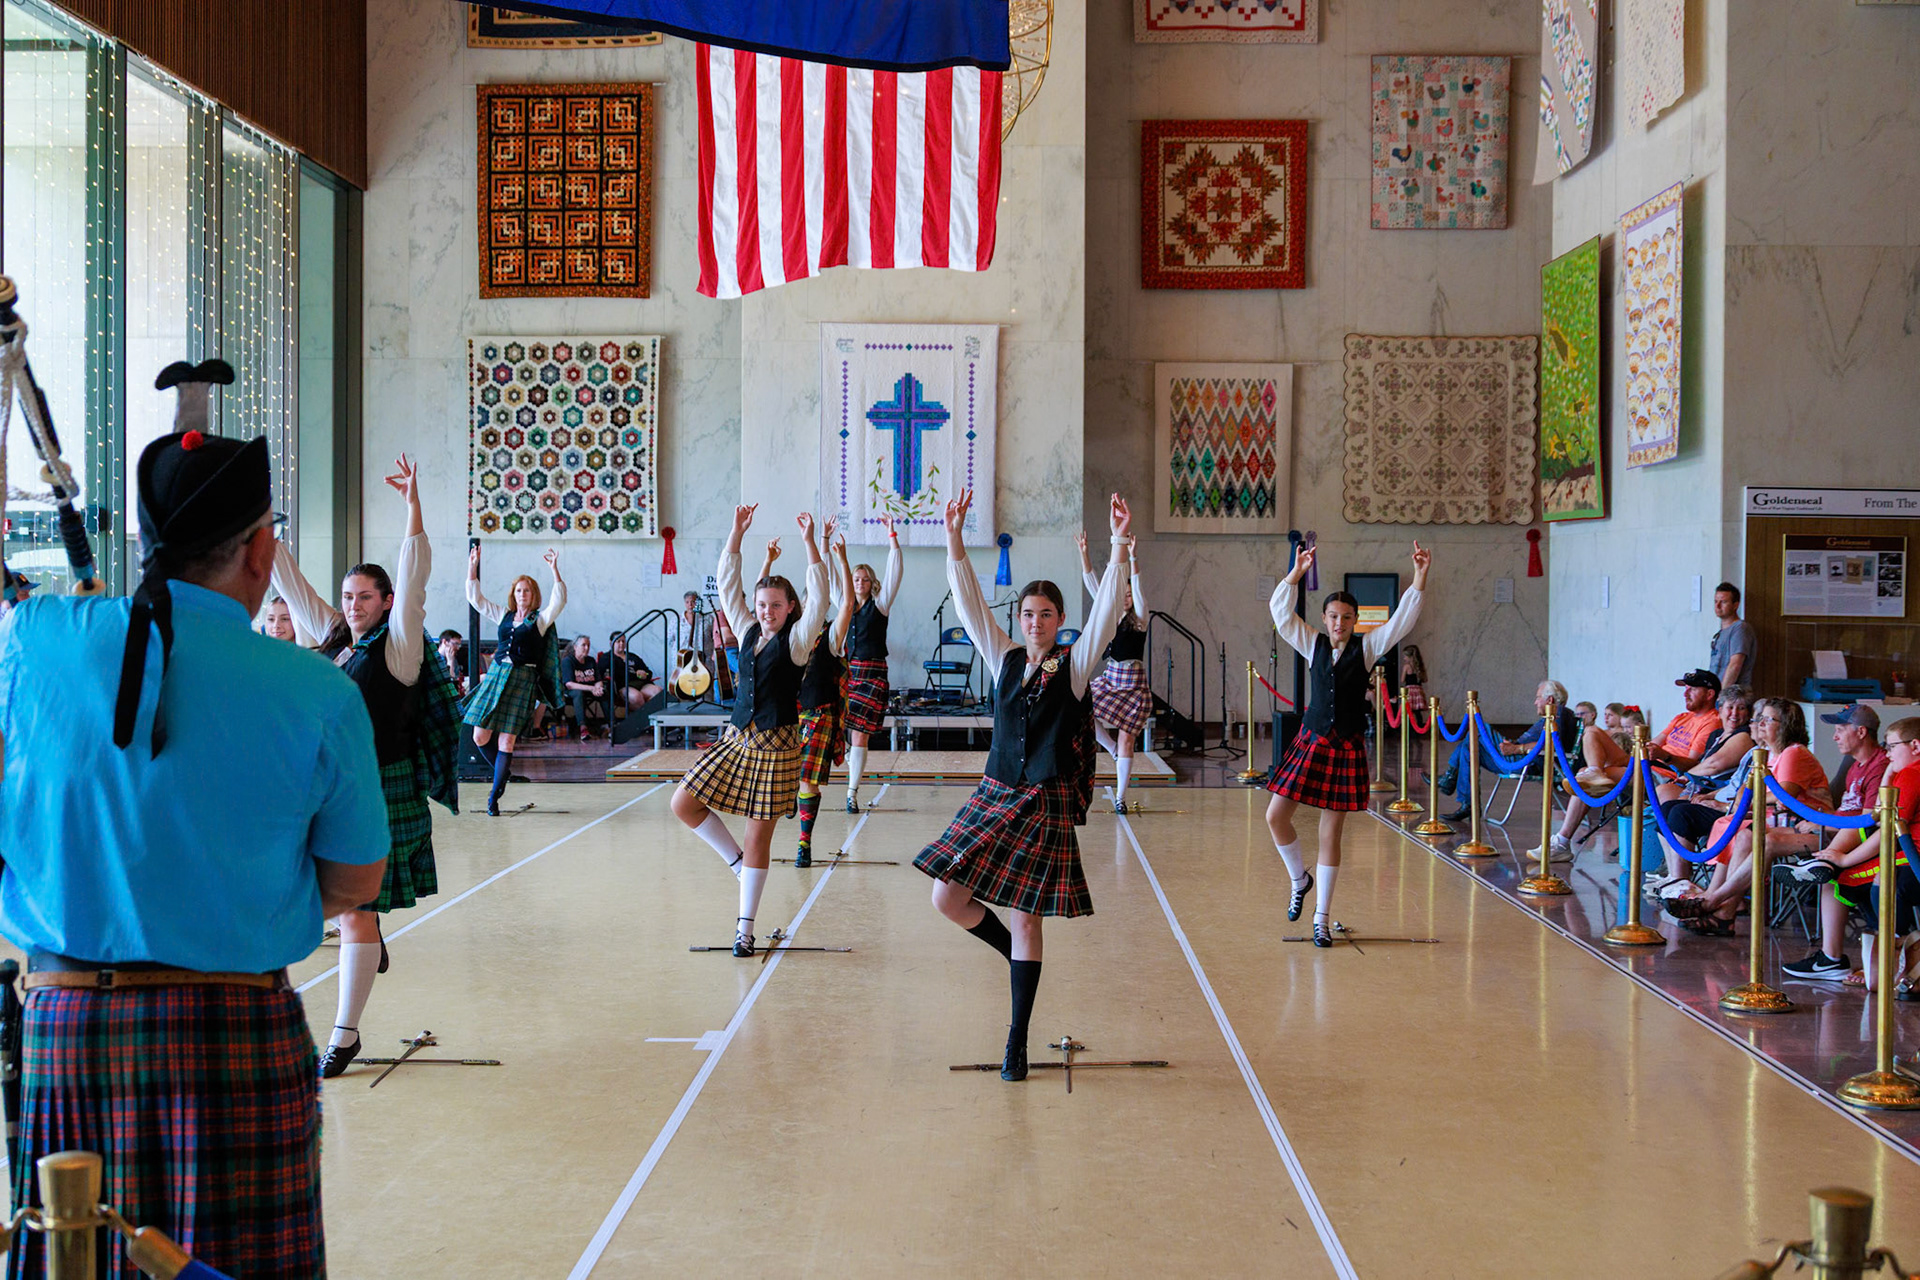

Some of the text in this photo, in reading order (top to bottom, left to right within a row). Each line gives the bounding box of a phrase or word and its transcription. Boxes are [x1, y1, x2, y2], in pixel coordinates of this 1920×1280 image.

[1753, 493, 1822, 506] Goldenseal
[1864, 498, 1918, 508] From The
